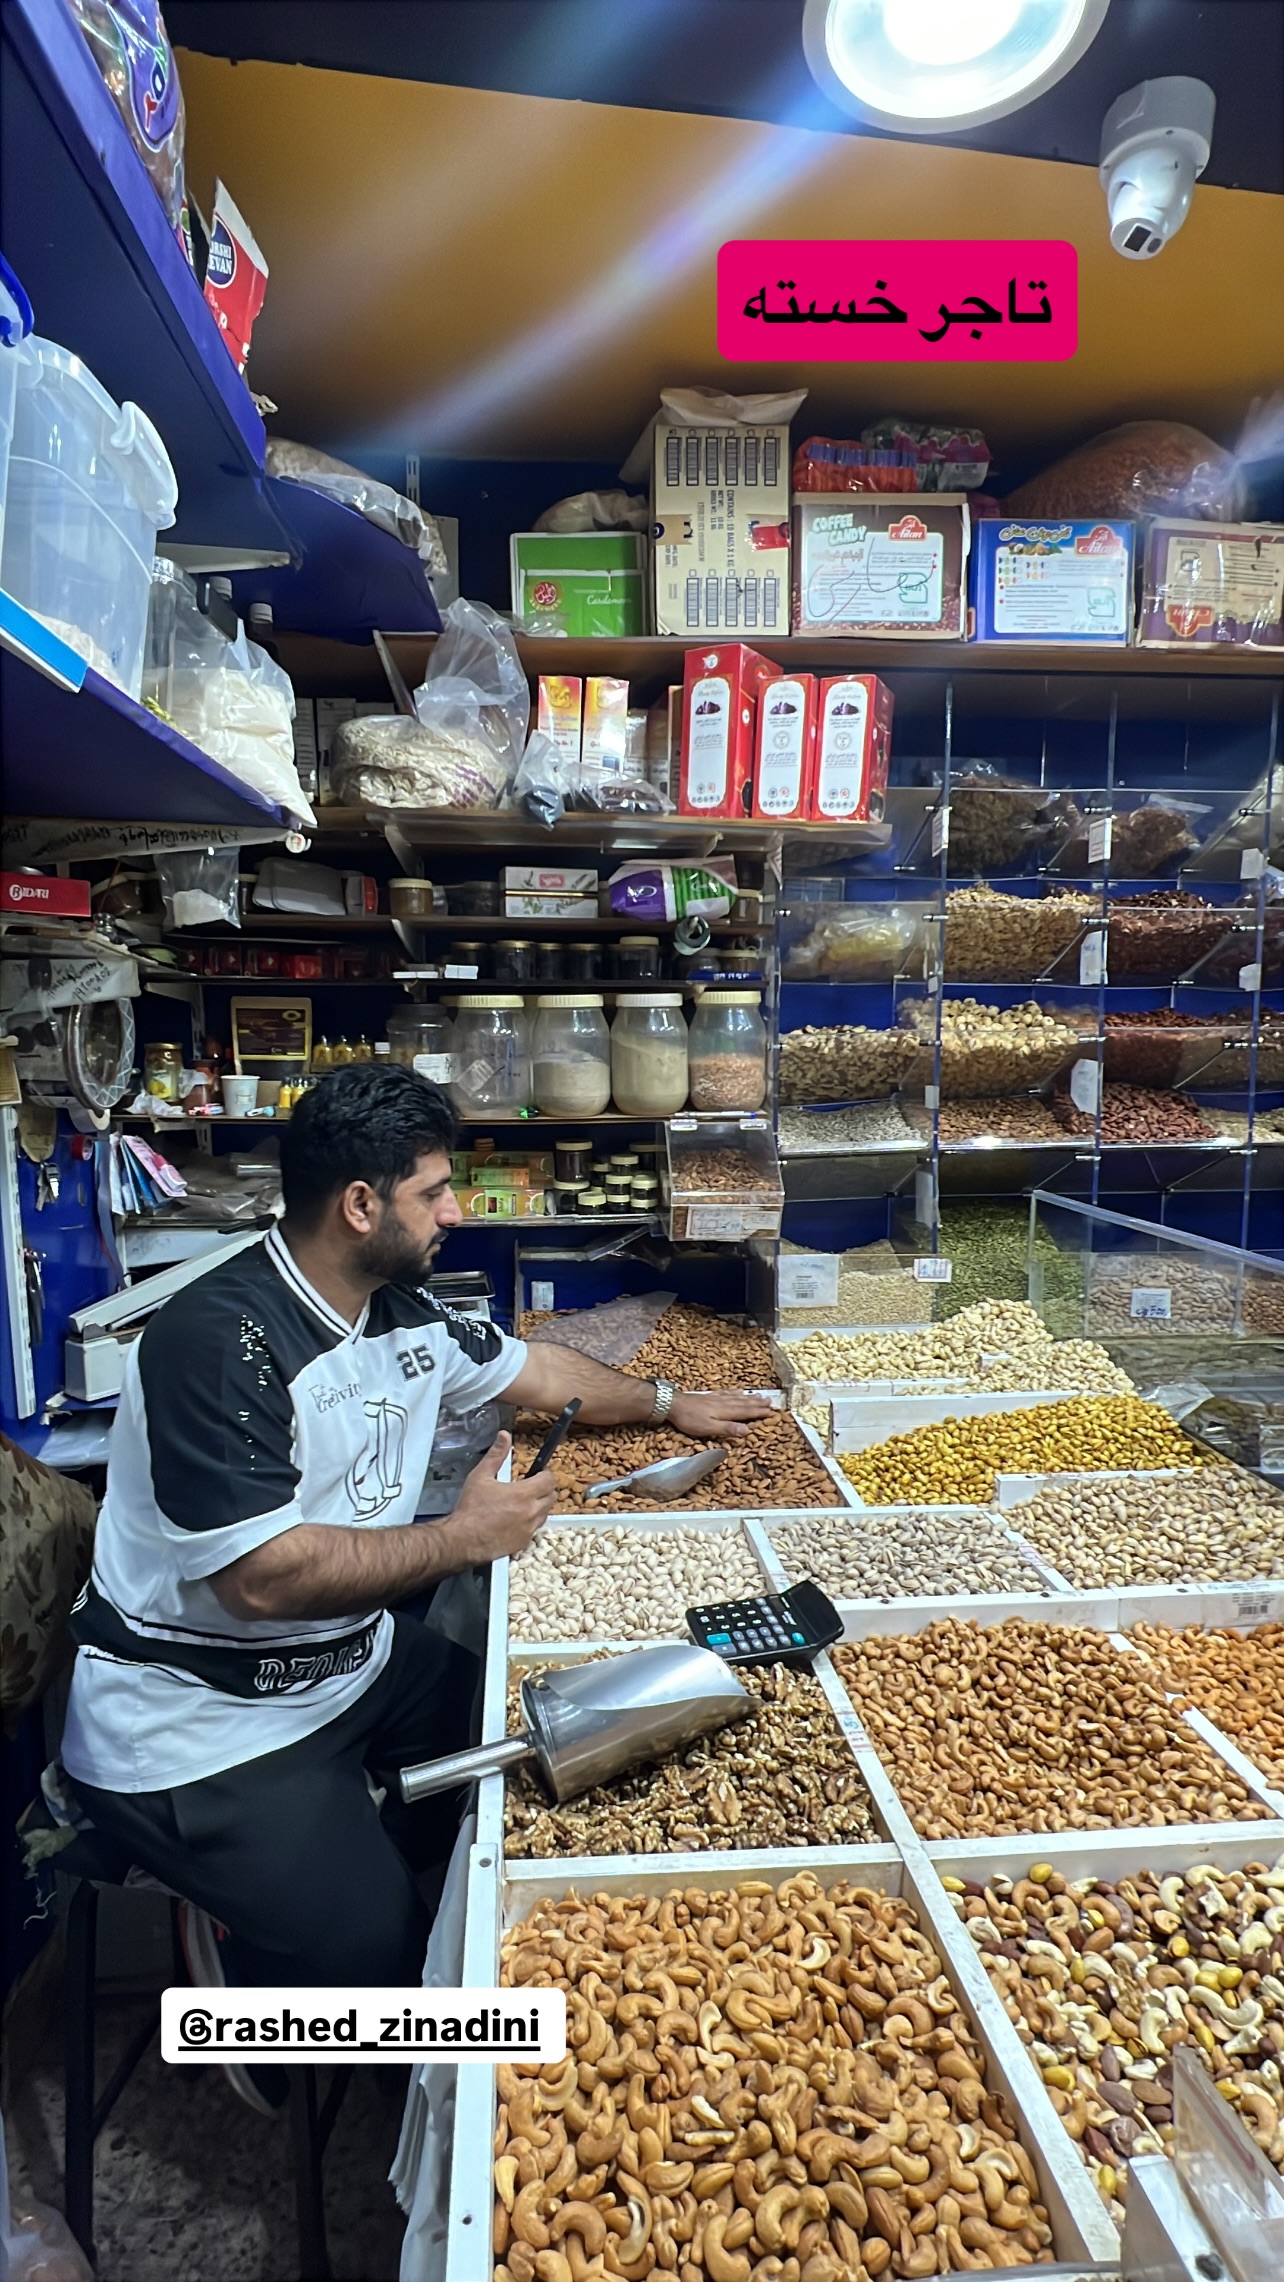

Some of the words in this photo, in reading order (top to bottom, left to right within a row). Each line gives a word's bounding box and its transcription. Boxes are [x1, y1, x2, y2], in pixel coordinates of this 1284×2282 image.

[811, 512, 854, 534] COFFEE
[828, 525, 868, 547] CANDY
[396, 1343, 436, 1382] 25
